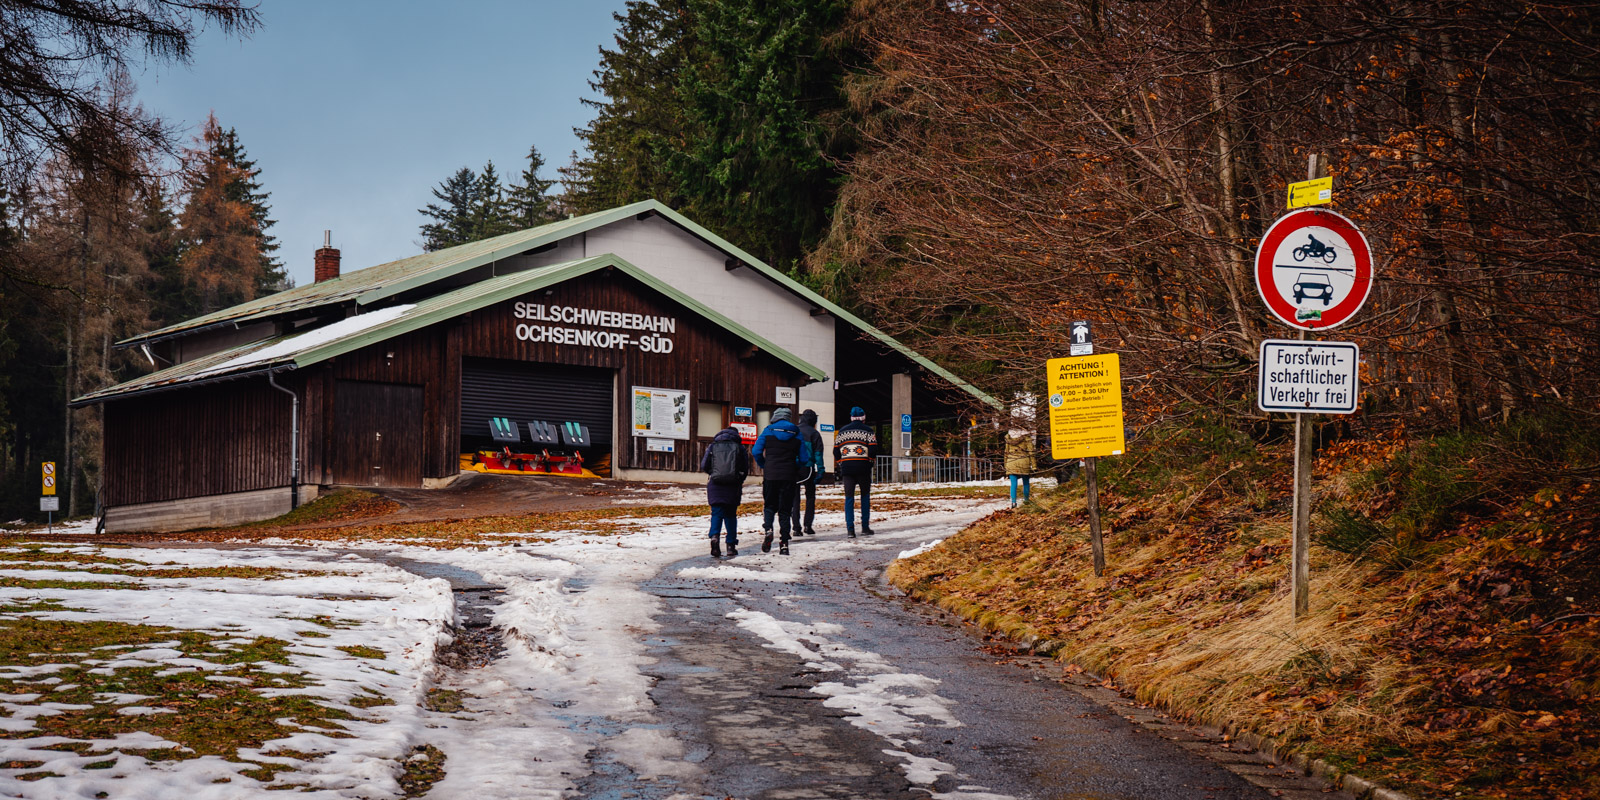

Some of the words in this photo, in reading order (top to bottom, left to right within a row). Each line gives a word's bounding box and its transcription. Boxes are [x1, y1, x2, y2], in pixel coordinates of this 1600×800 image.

[513, 301, 676, 334] SEILSCHWEBEBAHN
[515, 323, 674, 354] OCHSENKOPF-SÜD
[1277, 348, 1344, 366] Forstwirt-
[1059, 370, 1104, 380] ATTENTION
[1060, 362, 1099, 371] ACHTUNG
[1270, 368, 1348, 385] schaftlicher
[1270, 386, 1320, 403] Verkehr
[1325, 388, 1347, 404] frei
